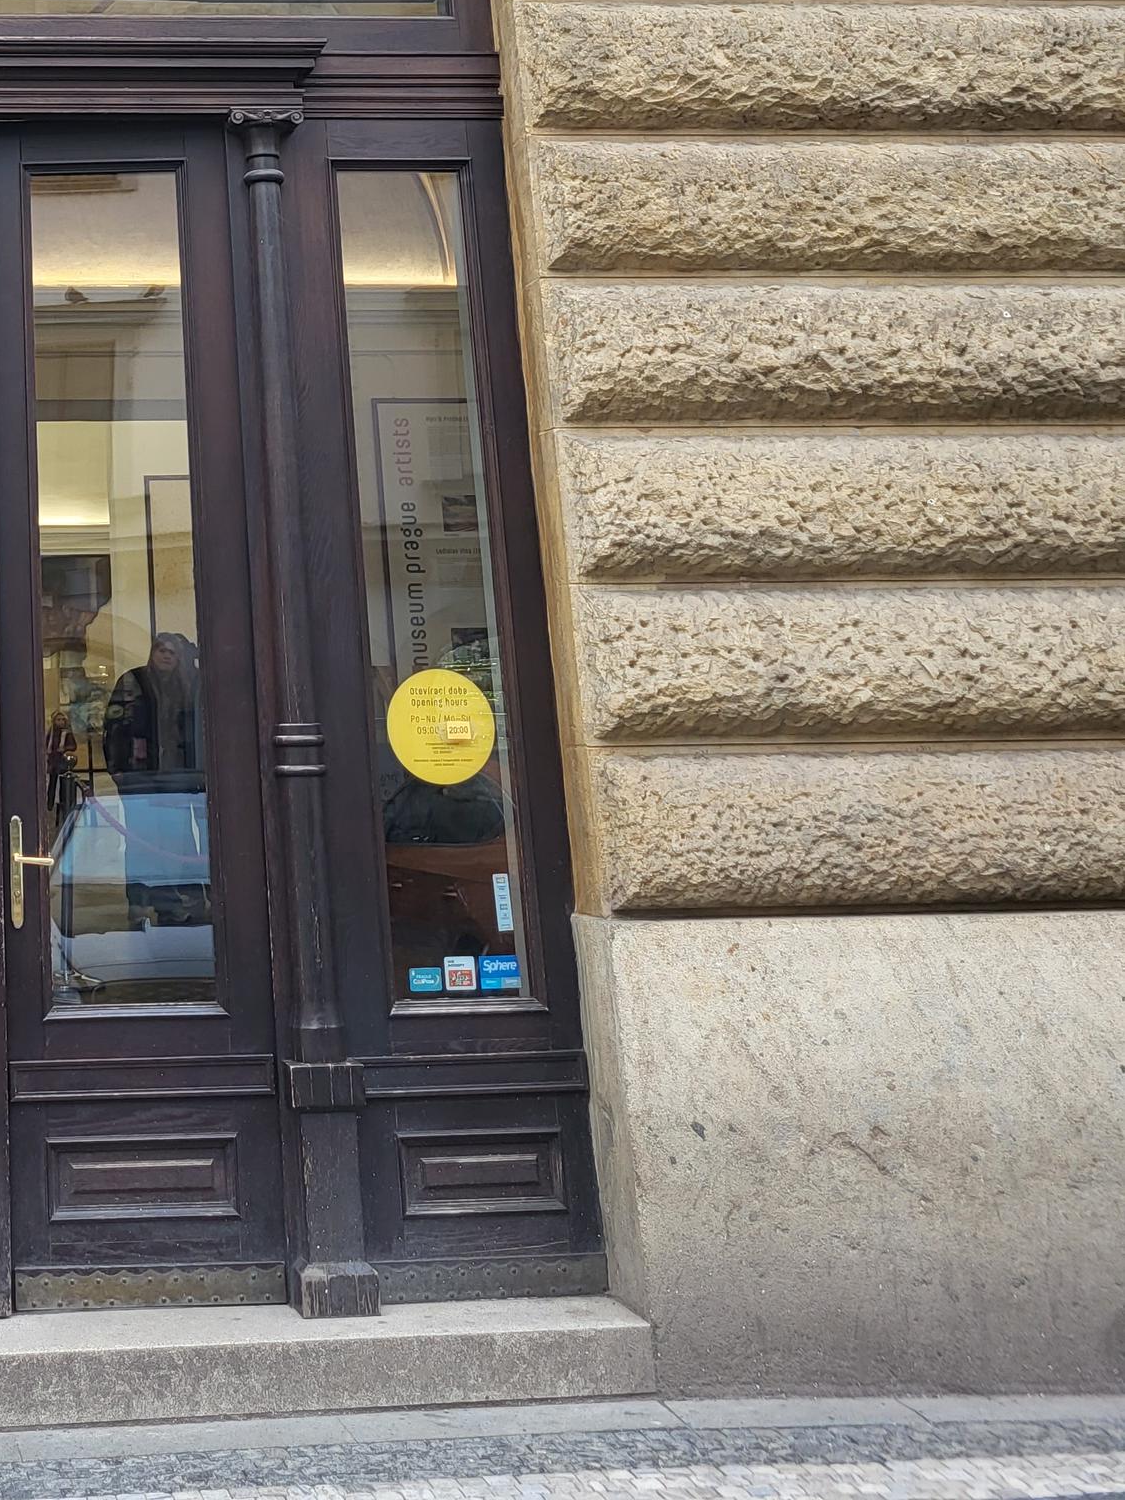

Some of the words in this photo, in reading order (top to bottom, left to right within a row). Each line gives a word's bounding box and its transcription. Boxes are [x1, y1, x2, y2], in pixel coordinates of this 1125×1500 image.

[393, 417, 413, 486] artists
[400, 501, 426, 574] prague
[448, 686, 468, 695] doba
[411, 698, 443, 708] Opening
[445, 697, 468, 706] hours
[449, 726, 468, 734] 20:00
[482, 959, 517, 973] Sphere
